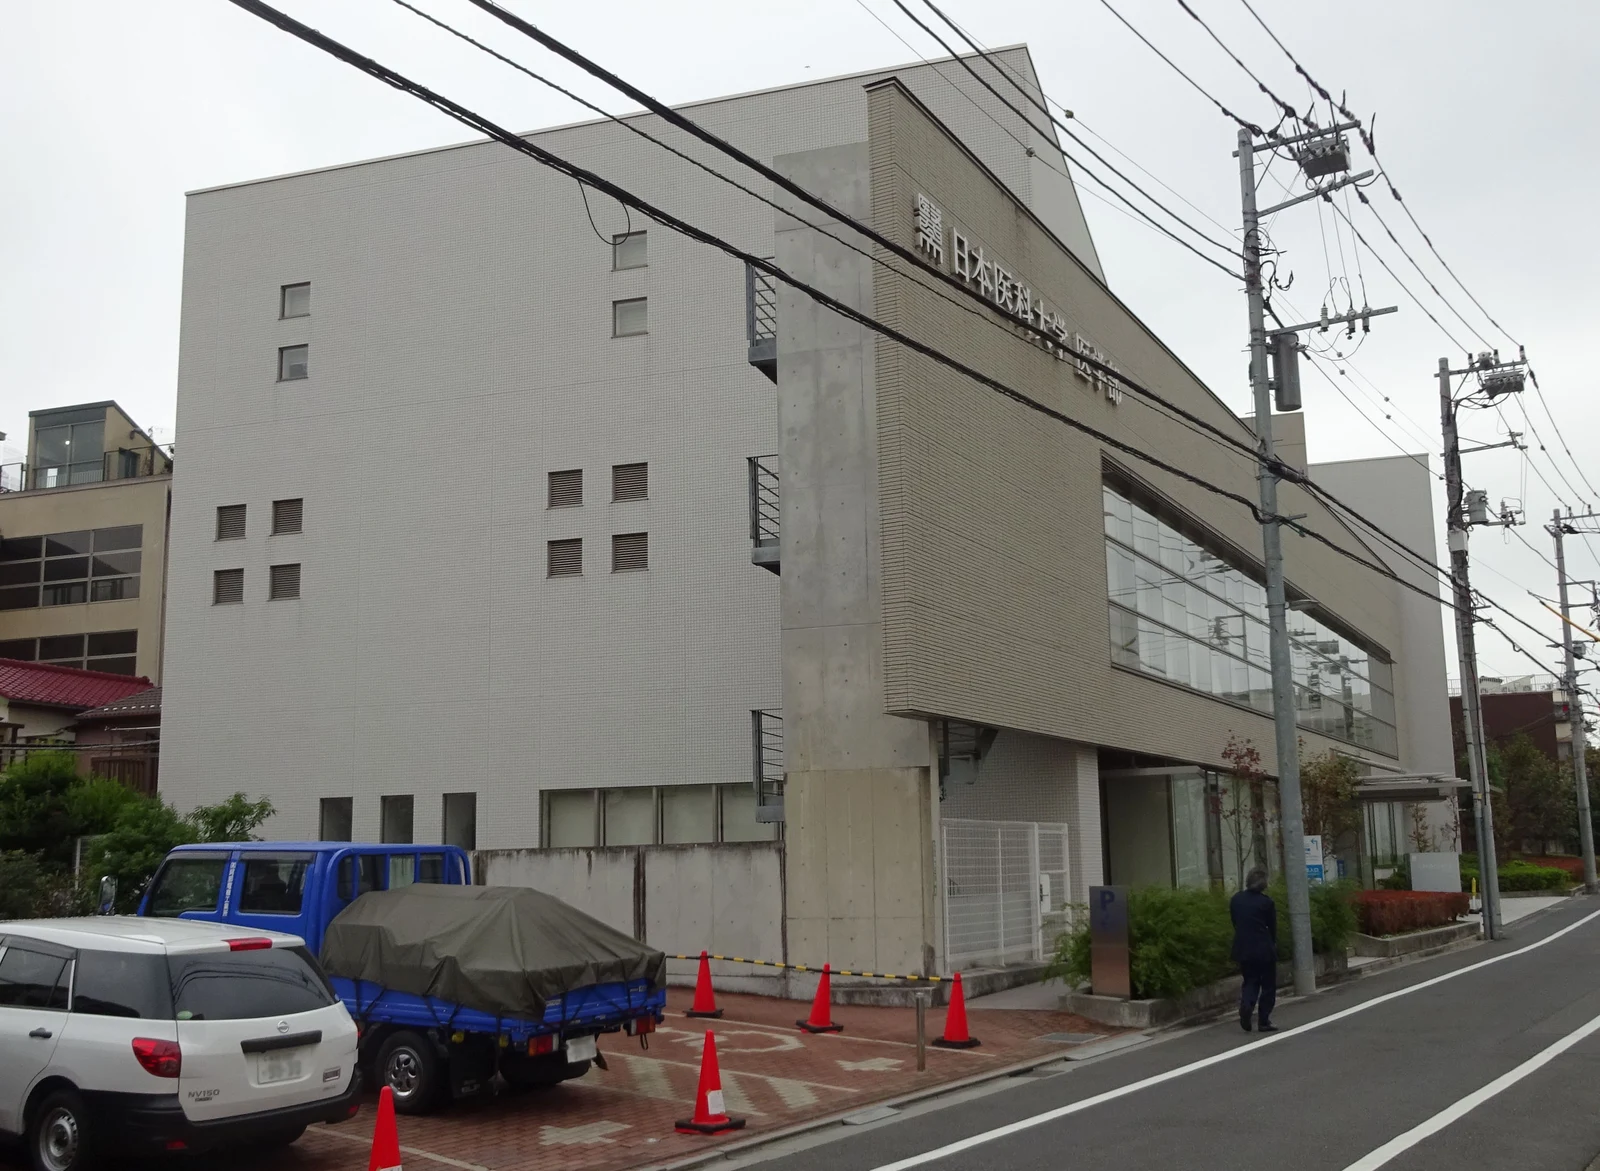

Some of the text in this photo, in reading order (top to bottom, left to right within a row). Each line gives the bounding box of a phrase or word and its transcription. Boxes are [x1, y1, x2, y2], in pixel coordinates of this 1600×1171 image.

[951, 226, 1068, 359] 日本医科大学
[1099, 890, 1115, 912] P
[188, 1088, 220, 1098] NV150
